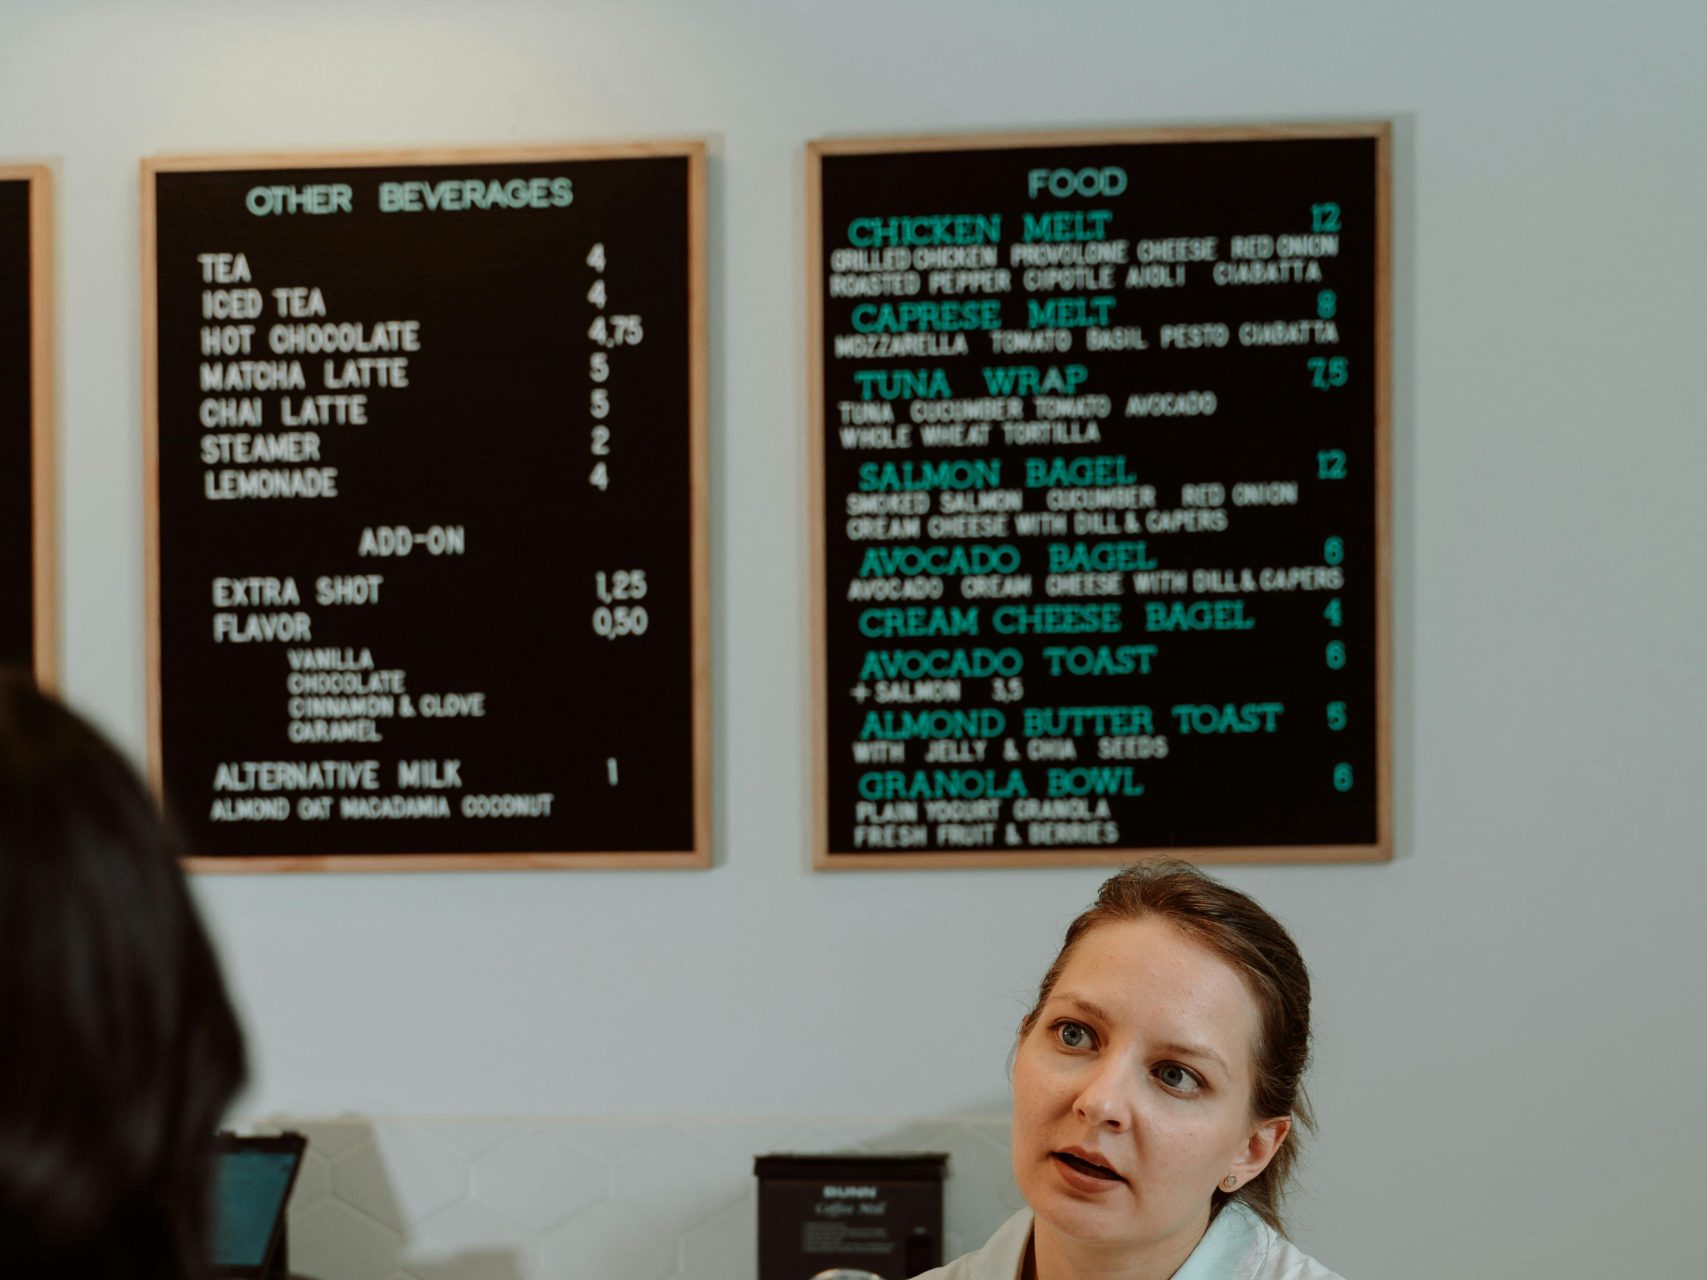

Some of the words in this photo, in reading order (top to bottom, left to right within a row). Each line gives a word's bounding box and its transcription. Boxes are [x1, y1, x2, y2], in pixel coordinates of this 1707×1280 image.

[246, 183, 352, 217] OTHER
[379, 178, 573, 213] BEVERAGES
[1028, 167, 1127, 199] FOOD
[848, 214, 1002, 247] CHICKEN
[1023, 210, 1112, 242] MELT
[1310, 202, 1340, 234] 12
[199, 253, 250, 284] TEA
[586, 243, 605, 273] 4
[831, 246, 911, 273] GRILLED
[913, 244, 997, 271] CHICKEN
[1010, 241, 1128, 267] PROVOLONE
[1138, 237, 1217, 262] CHEESE
[1231, 235, 1273, 260] RED
[1276, 234, 1339, 258] ONION
[830, 272, 920, 298] ROASTED
[929, 270, 1011, 294] PEPPER
[1126, 263, 1186, 288] AIOLI
[1213, 259, 1321, 286] CIABATTA
[202, 290, 262, 319] ICED
[273, 288, 325, 317] TEA
[587, 280, 607, 310] 4
[852, 301, 1002, 334] CAPRESE
[1027, 296, 1116, 328] MELT
[1317, 289, 1336, 319] 8
[201, 325, 255, 355] HOT
[270, 321, 420, 353] CHOCOLATE
[835, 333, 967, 359] MOZZARELLA
[991, 329, 1072, 353] TOMATO
[1087, 327, 1148, 352] BASIL
[1160, 324, 1229, 349] PESTO
[1239, 321, 1338, 347] CIABATTA
[200, 362, 305, 391] MATCHA
[325, 358, 408, 389] LATTE
[590, 354, 609, 383] 5
[854, 370, 951, 400] TUNA
[982, 365, 1087, 396] WRAP
[200, 399, 261, 427] CHAI
[281, 395, 367, 426] LATTE
[590, 389, 609, 418] 5
[839, 401, 895, 425] TUNA
[911, 398, 1023, 423] CUCUMBER
[1034, 396, 1110, 420] TOMATO
[1126, 392, 1217, 417] AVOCADO
[201, 433, 320, 463] STEAMER
[591, 426, 610, 455] 2
[839, 425, 912, 450] WHOLE
[921, 424, 992, 448] WHEAT
[1003, 420, 1100, 445] TORTILLA
[205, 469, 338, 499] LEMONADE
[589, 462, 609, 491] 4
[858, 458, 1001, 493] SALMON
[1026, 455, 1137, 488] BAGEL
[1316, 449, 1347, 479] 12
[847, 492, 930, 516] SMOKED
[940, 491, 1022, 514] SALMON
[1047, 487, 1156, 512] CUCUMBER
[1182, 485, 1226, 508] RED
[1233, 483, 1297, 506] ONION
[847, 517, 920, 540] CREAM
[928, 515, 1009, 538] CHEESE
[1015, 513, 1068, 537] WITH
[1074, 513, 1122, 536] DILL
[1124, 513, 1140, 535] &
[1145, 509, 1228, 534] CAPERS
[359, 527, 464, 557] ADD-ON
[859, 544, 1021, 577] AVOCADO
[1048, 541, 1157, 572] BAGEL
[1324, 537, 1344, 565] 6
[213, 577, 299, 606] EXTRA
[316, 575, 383, 605] SHOT
[848, 575, 943, 601] AVOCADO
[961, 575, 1032, 598] CREAM
[1046, 572, 1124, 597] CHEESE
[1133, 571, 1188, 595] WITH
[1193, 570, 1240, 593] DILL
[1242, 569, 1258, 592] &
[1259, 568, 1343, 592] CAPERS
[213, 613, 311, 643] FLAVOR
[858, 607, 980, 637] CREAM
[992, 604, 1122, 634] CHEESE
[1146, 600, 1255, 632] BAGEL
[1323, 598, 1342, 628] 4
[288, 649, 373, 671] VANILLA
[859, 648, 1024, 680] AVOCADO
[1043, 645, 1158, 675] TOAST
[1325, 641, 1346, 669] 6
[288, 671, 406, 695] CHOCOLATE
[851, 684, 871, 703] +
[875, 681, 961, 703] SALMON
[288, 695, 394, 718] CINNAMON
[401, 695, 415, 718] &
[419, 694, 485, 717] CLOVE
[859, 709, 1006, 740] ALMOND
[1024, 706, 1153, 736] BUTTER
[1172, 703, 1284, 733] TOAST
[1326, 703, 1347, 731] 5
[288, 720, 382, 742] CARAMEL
[853, 741, 904, 764] WITH
[924, 739, 988, 763] JELLY
[1003, 740, 1019, 761] &
[1027, 738, 1077, 761] CHIA
[1099, 736, 1168, 759] SEEDS
[214, 762, 379, 790] ALTERNATIVE
[399, 760, 462, 788] MILK
[607, 758, 618, 785] 1
[858, 770, 1028, 800] GRANOLA
[1047, 767, 1144, 796] BOWL
[1333, 764, 1354, 792] 6
[211, 798, 290, 821] ALMOND
[297, 797, 333, 820] OAT
[340, 795, 450, 819] MACADAMIA
[462, 794, 554, 817] COCONUT
[855, 801, 917, 823] PLAIN
[925, 800, 999, 822] YOGURT
[1013, 798, 1111, 821] GRANOLA
[854, 824, 927, 847] FRESH
[936, 823, 995, 846] FRUIT
[1005, 823, 1022, 845] &
[1028, 821, 1119, 844] BERRIES
[823, 1186, 878, 1198] BUNN
